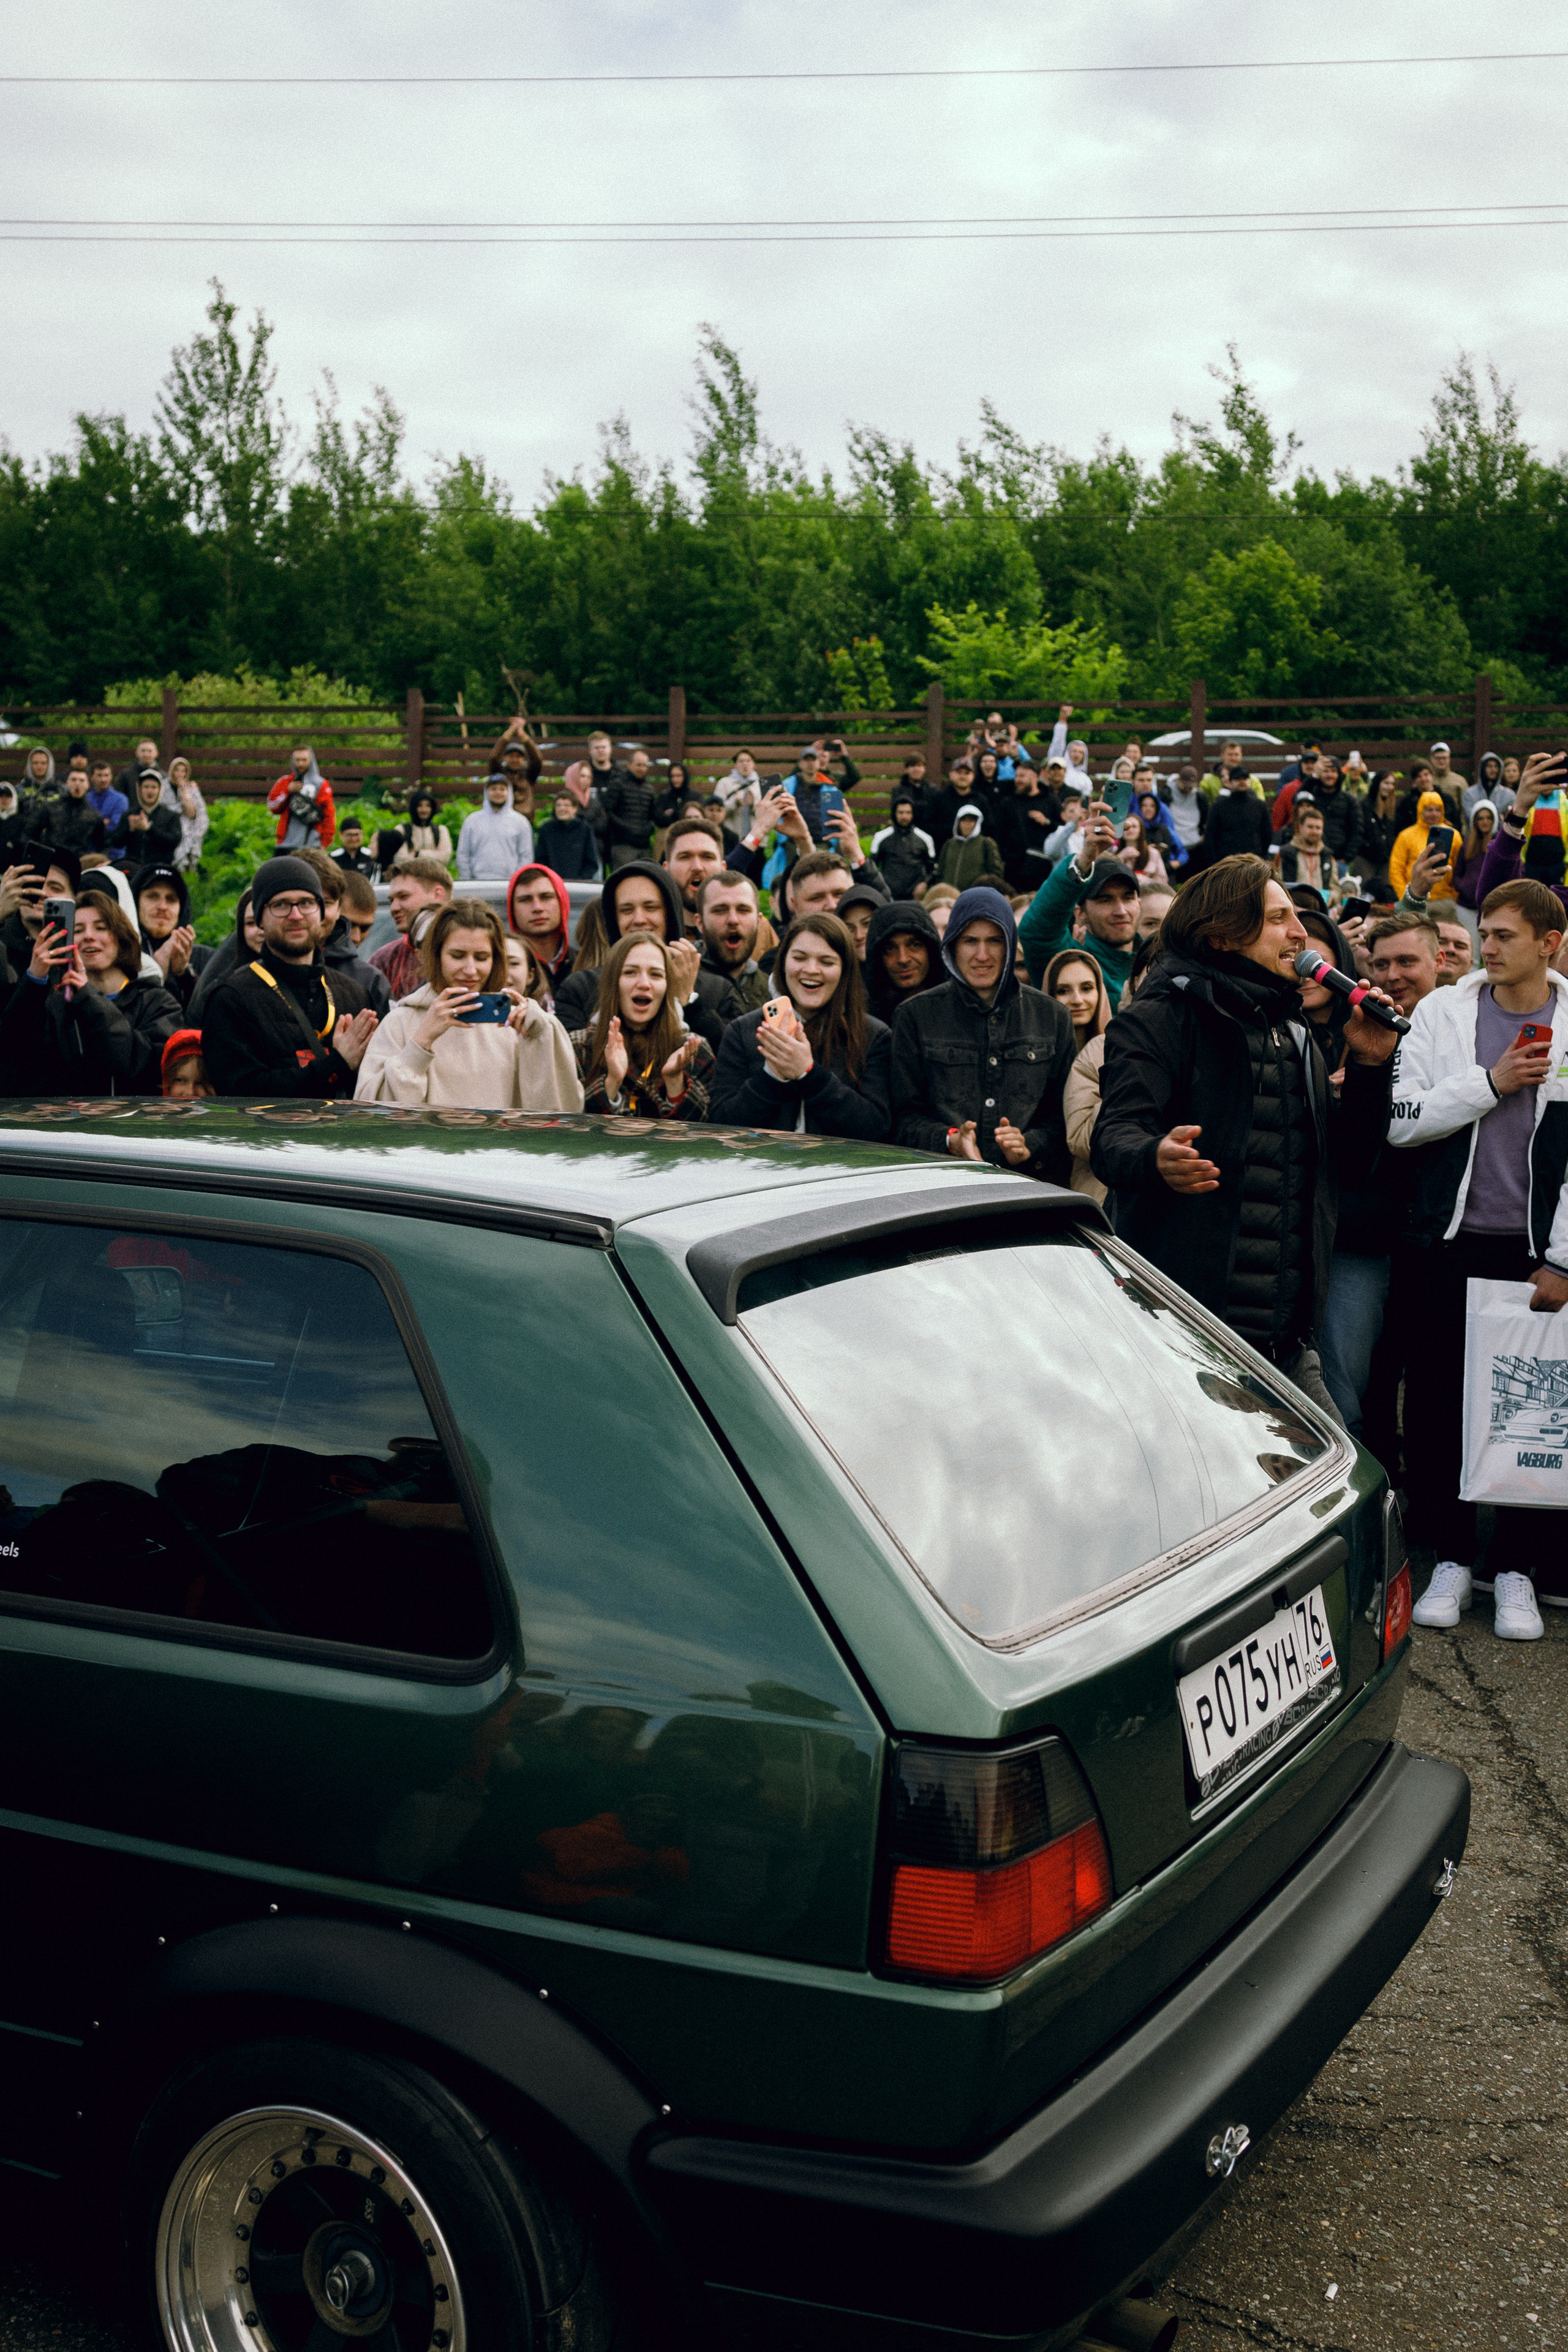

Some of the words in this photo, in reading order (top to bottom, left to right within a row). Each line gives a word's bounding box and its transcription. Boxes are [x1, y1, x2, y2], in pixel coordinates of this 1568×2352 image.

[1517, 1452, 1562, 1469] VAGBURG
[1295, 1595, 1322, 1655] 76
[1305, 1654, 1322, 1680] RUS
